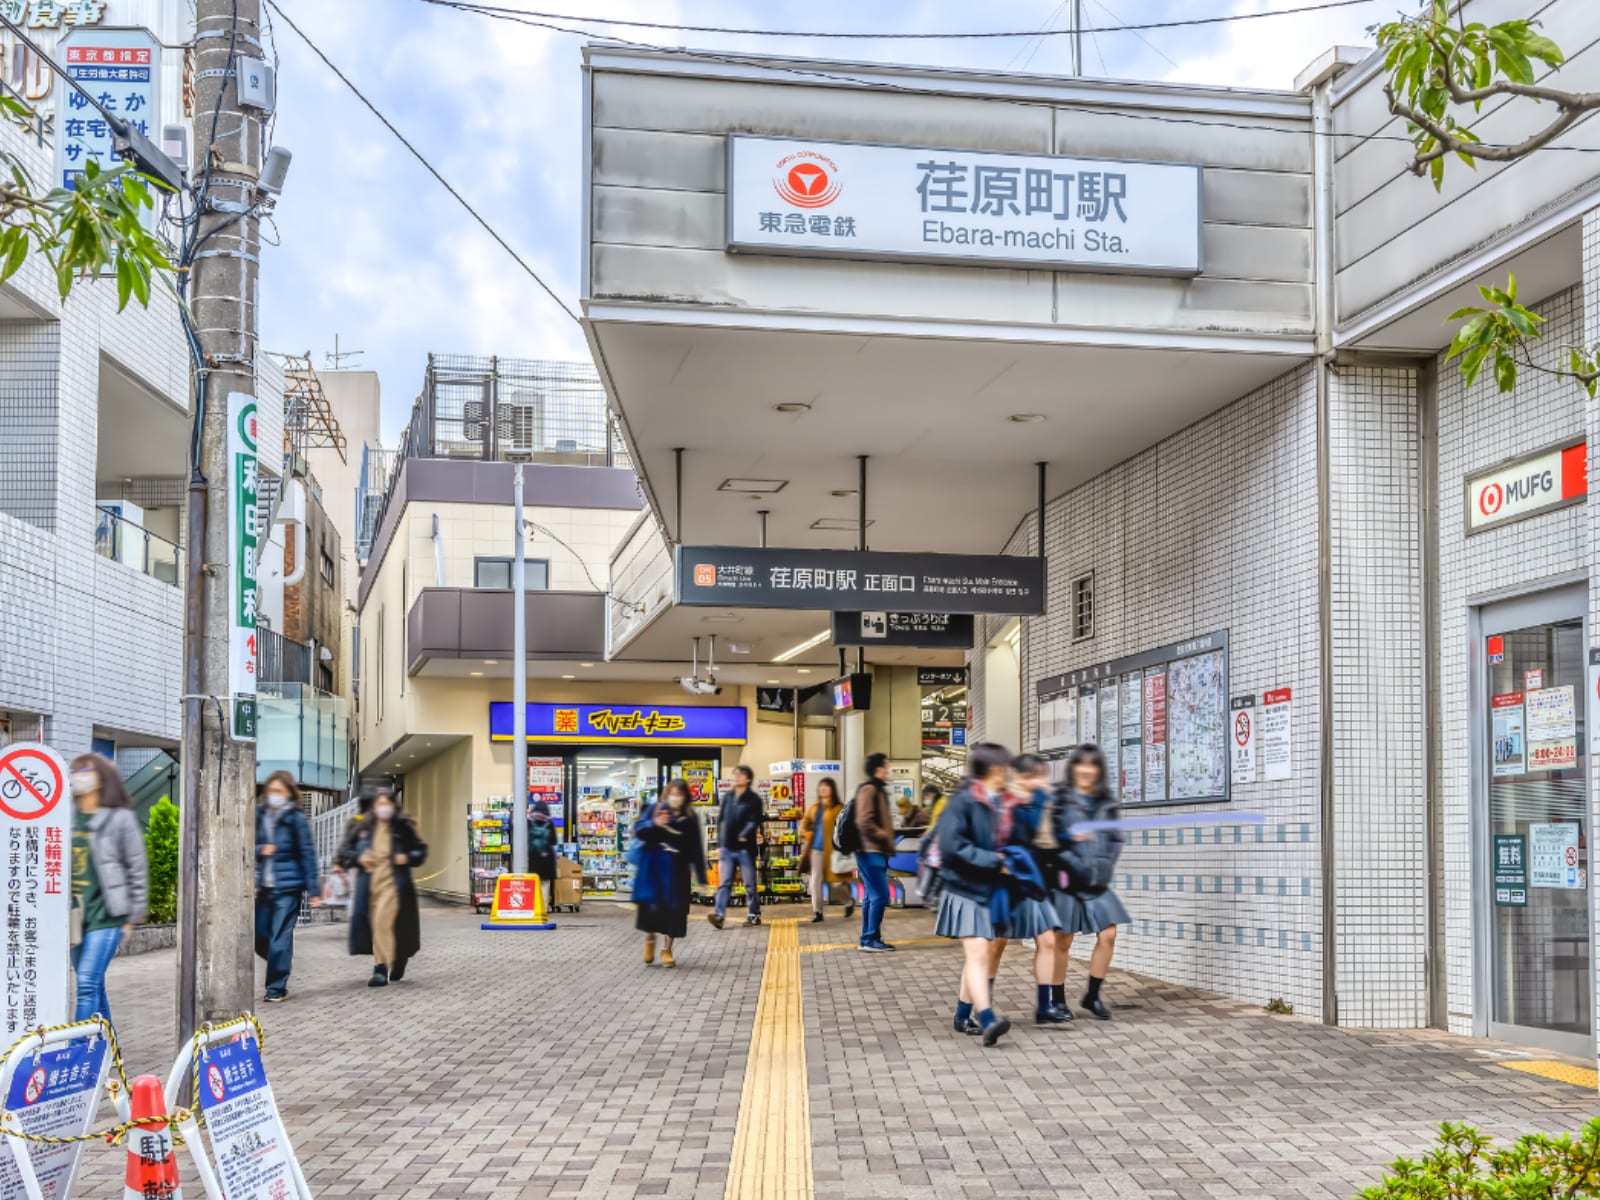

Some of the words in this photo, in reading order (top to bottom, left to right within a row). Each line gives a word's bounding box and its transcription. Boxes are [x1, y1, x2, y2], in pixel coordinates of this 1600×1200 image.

[69, 48, 149, 63] 東京都指定
[69, 91, 146, 111] ゆたか
[916, 160, 1128, 223] 荏原町駅
[758, 211, 857, 238] 東急電鉄
[922, 219, 1076, 250] Ebara-machi
[1084, 229, 1130, 253] Sta.
[1505, 470, 1553, 504] MUFG
[698, 574, 712, 583] 05
[769, 566, 857, 591] 荏原町駅
[864, 574, 916, 592] 正面口
[889, 612, 950, 625] きっぷうりば
[555, 709, 578, 732] 薬
[588, 709, 686, 735] マツモトキヨシ
[939, 705, 949, 722] 2
[44, 826, 63, 895] 駐輪禁止
[1498, 845, 1522, 865] 無料
